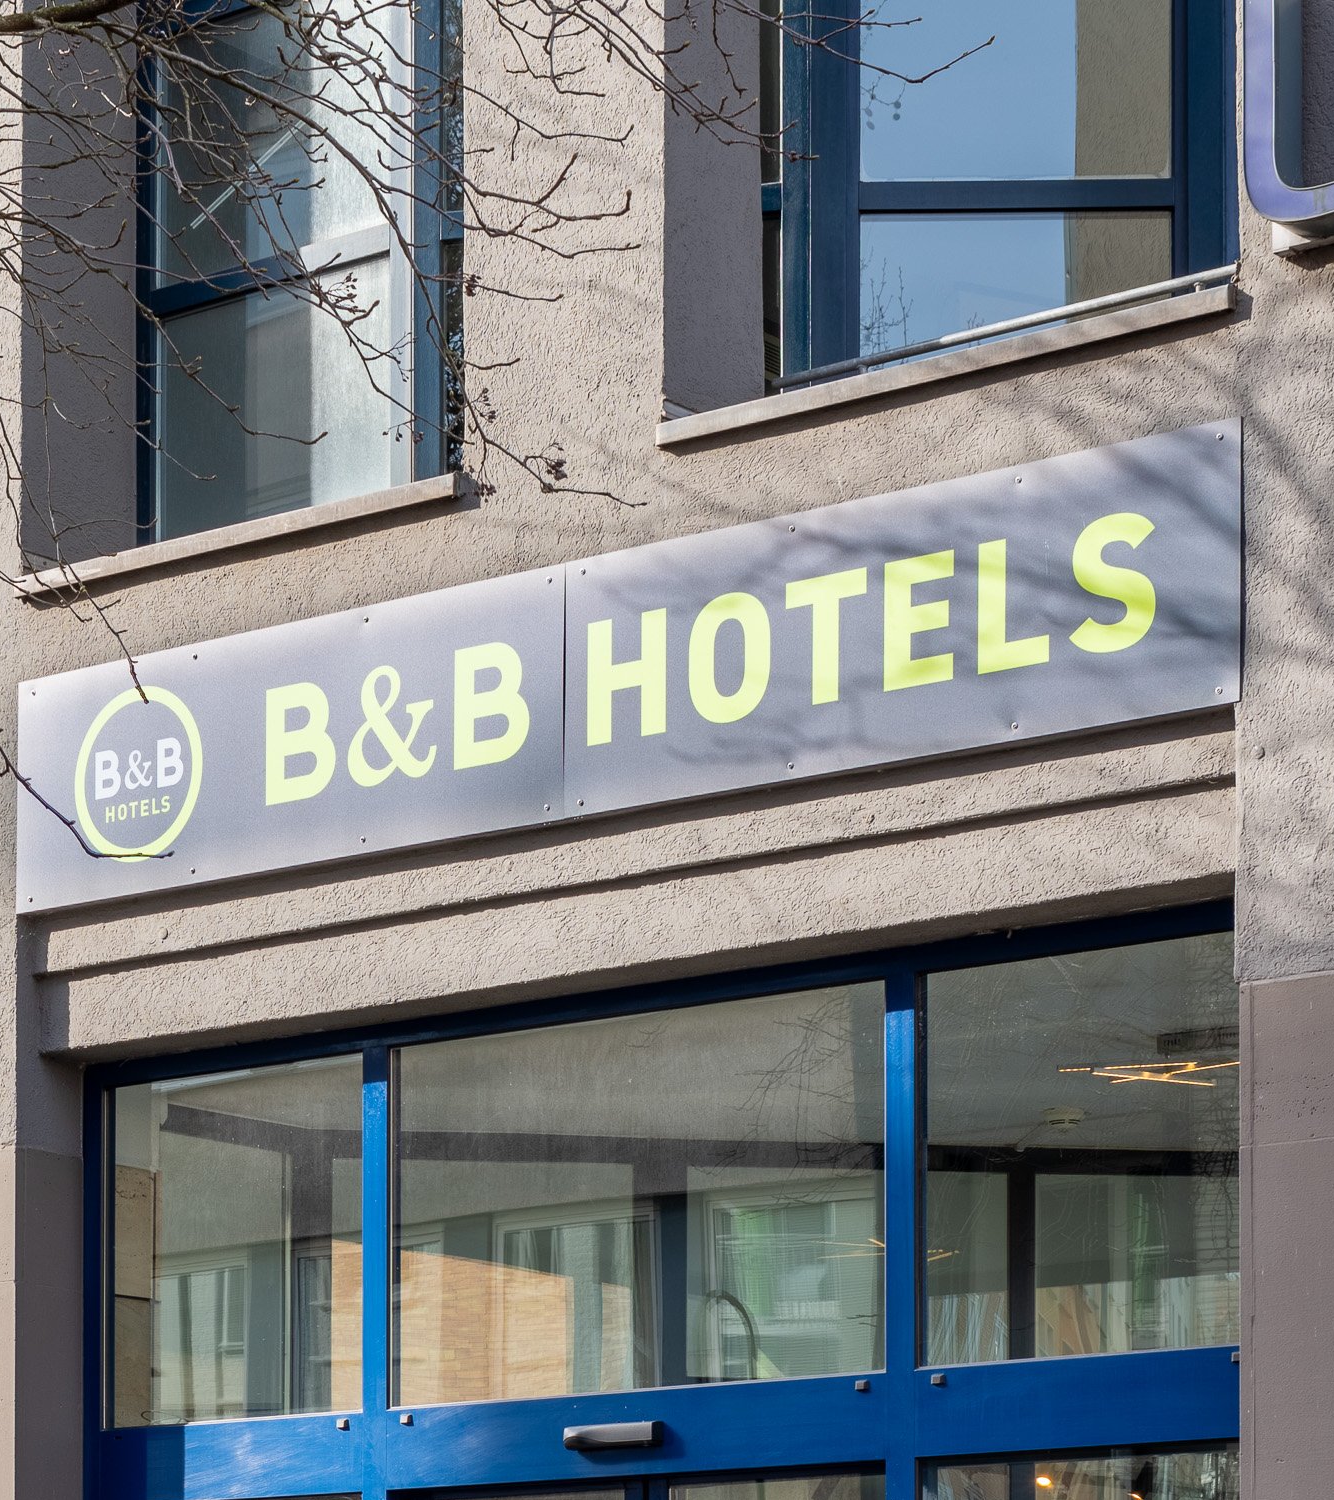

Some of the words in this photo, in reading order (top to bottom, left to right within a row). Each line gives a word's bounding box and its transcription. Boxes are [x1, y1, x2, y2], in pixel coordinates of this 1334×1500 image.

[264, 641, 532, 807] B&B
[585, 511, 1157, 748] HOTELS
[93, 737, 185, 800] B&B
[105, 796, 173, 825] HOTELS
